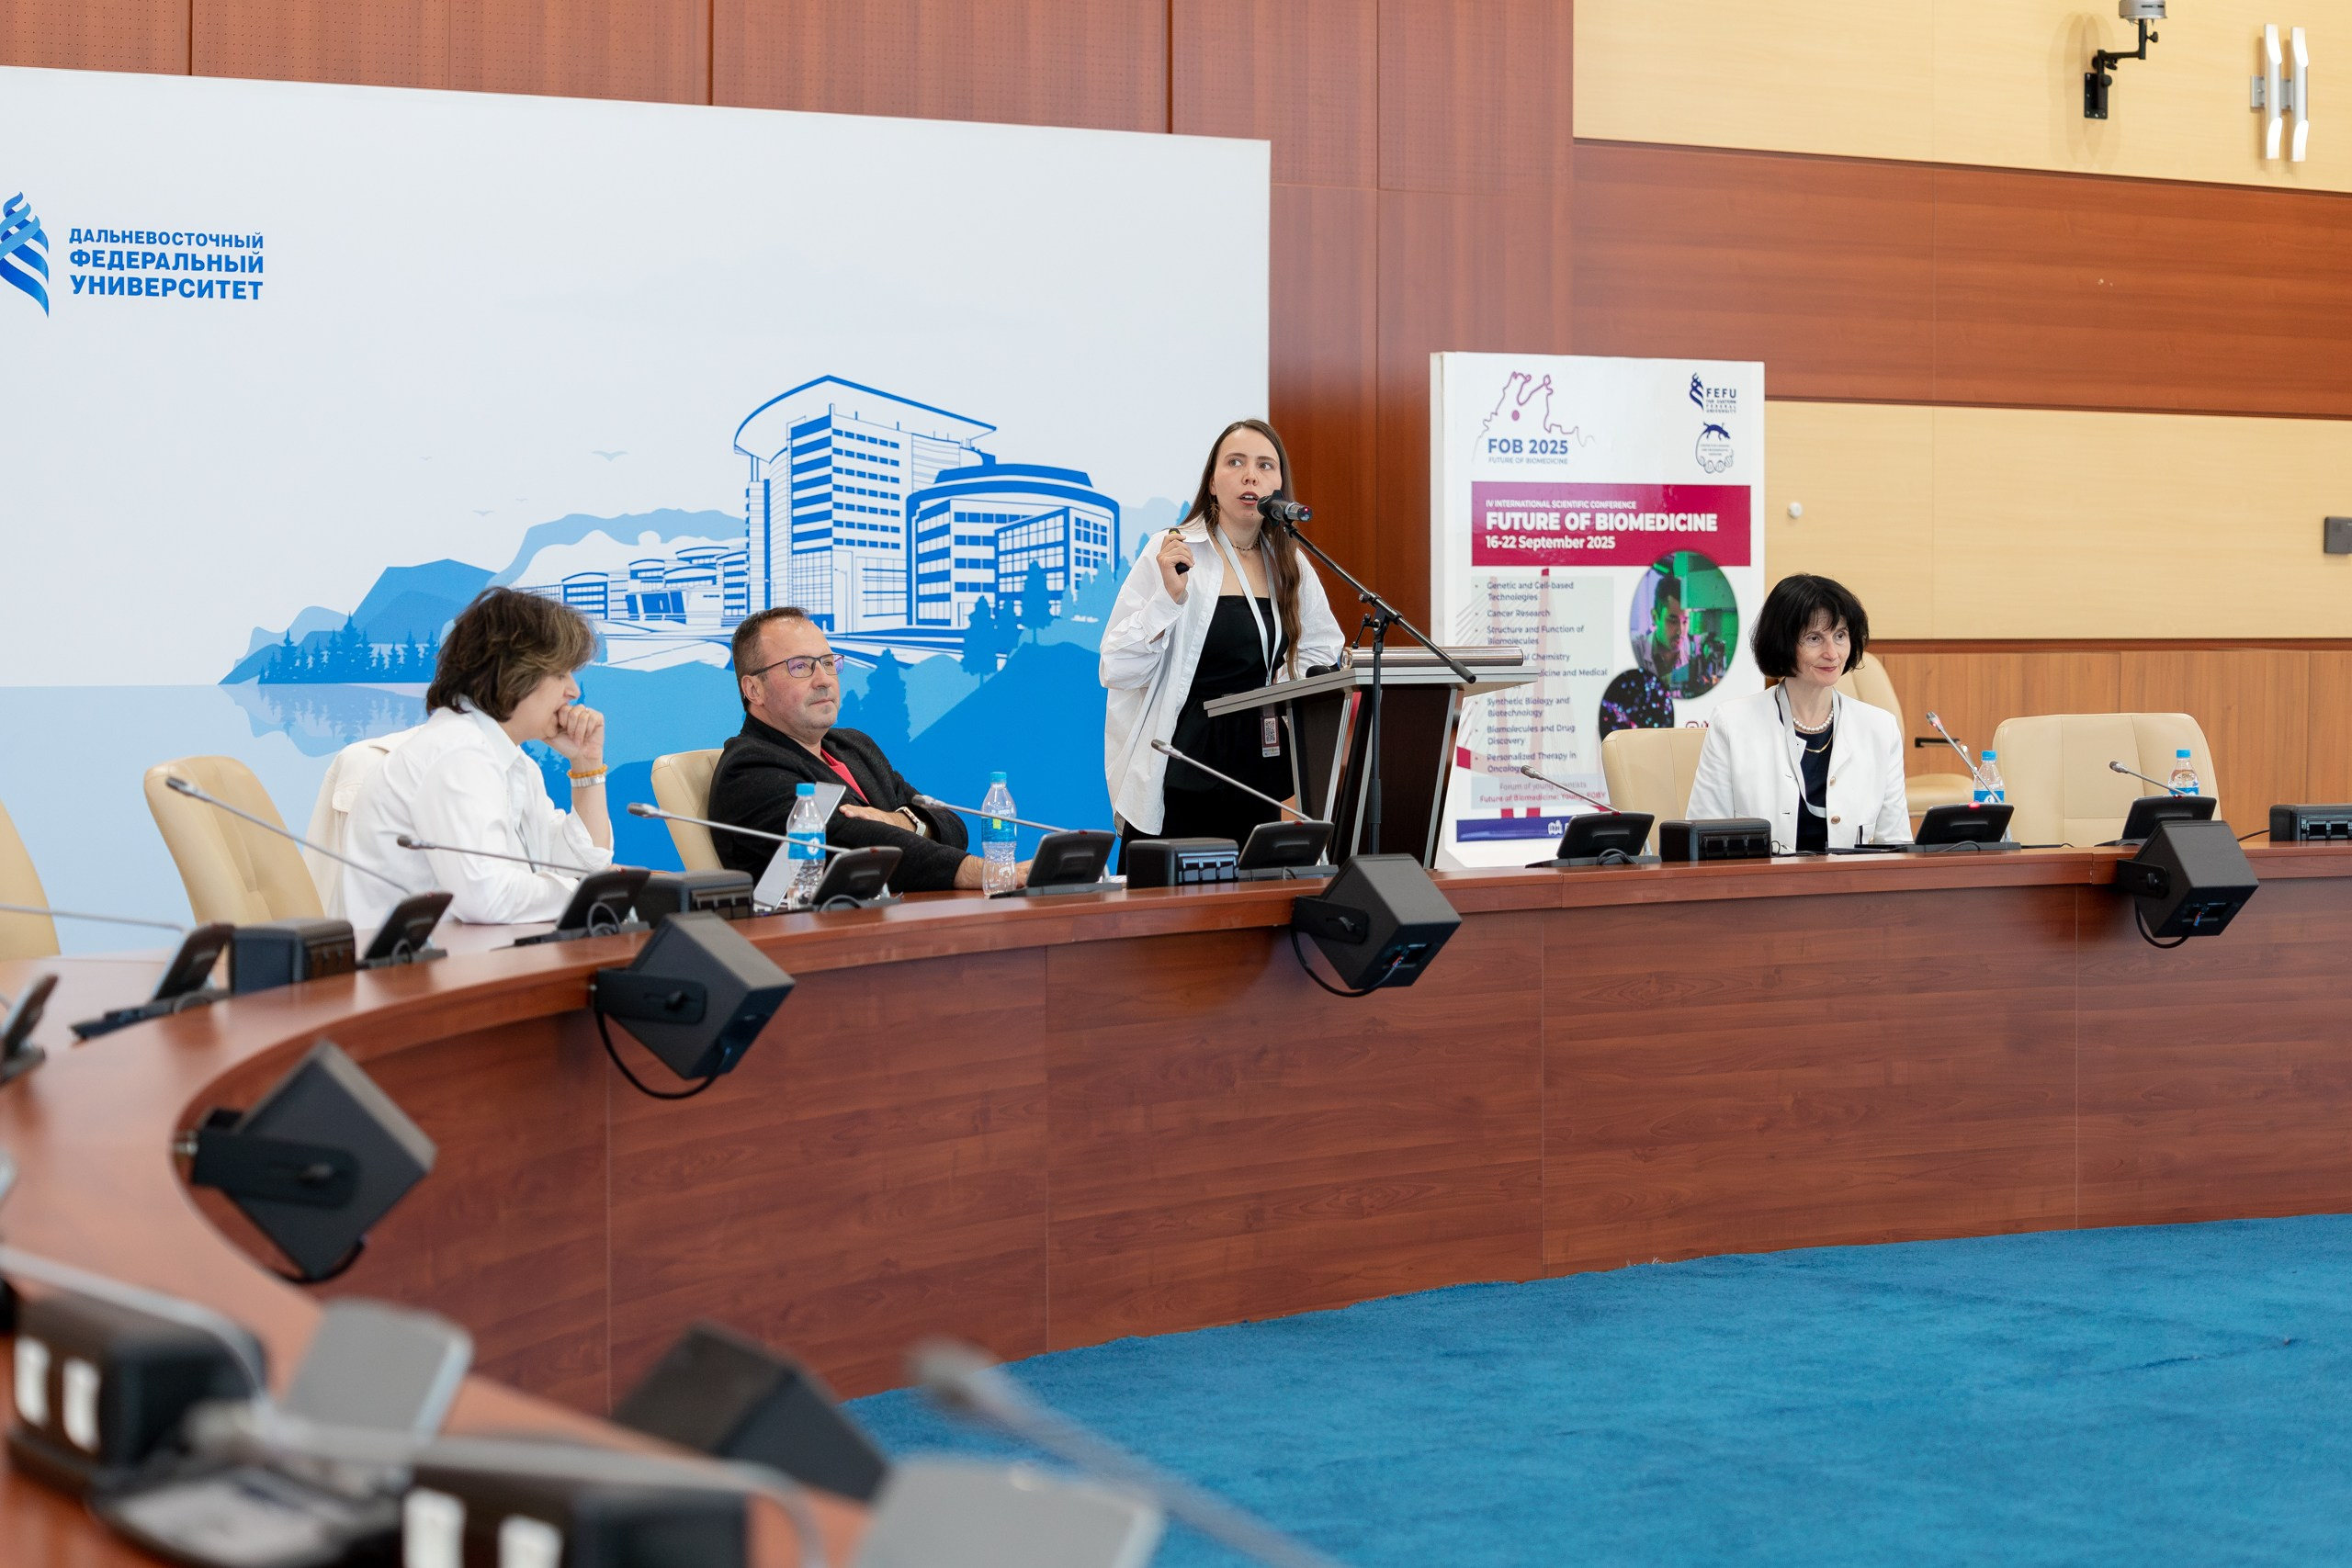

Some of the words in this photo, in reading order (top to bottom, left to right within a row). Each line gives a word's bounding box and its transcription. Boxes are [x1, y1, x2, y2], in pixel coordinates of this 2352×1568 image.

[69, 228, 264, 249] ДАЛЬНЕВОСТОЧНЫЙ
[70, 249, 264, 274] ФЕДЕРАЛЬНЫЙ
[70, 275, 264, 300] УНИВЕРСИТЕТ
[1706, 388, 1736, 399] FEFU
[1488, 438, 1523, 454] FOB
[1529, 439, 1568, 455] 2025
[1486, 499, 1494, 507] IV
[1495, 500, 1551, 508] INTERNATIONAL
[1552, 501, 1589, 509] SCIENTIFIC
[1590, 501, 1636, 510] CONFERENCE
[1486, 512, 1560, 530] FUTURE
[1565, 513, 1591, 531] OF
[1595, 513, 1718, 532] BIOMEDICINE
[1486, 535, 1517, 548] 16-22
[1519, 536, 1585, 551] September
[1587, 536, 1615, 549] 2025
[1487, 581, 1516, 590] Genetic
[1487, 593, 1538, 602] Technologies
[1487, 626, 1522, 634] Structure
[1487, 637, 1539, 645] Biomolecules
[1532, 653, 1570, 662] Chemistry
[1563, 669, 1577, 677] and
[1487, 696, 1522, 705] Synthetic
[1525, 696, 1553, 705] Biology
[1555, 696, 1570, 705] and
[1487, 708, 1543, 717] Biotechnology
[1487, 726, 1538, 734] Biomolecules
[1540, 725, 1555, 733] and
[1556, 725, 1576, 733] Drug
[1487, 737, 1525, 746] Discovery
[1538, 751, 1567, 761] Therapy
[1569, 751, 1577, 760] in
[1487, 764, 1521, 773] Oncolog
[1499, 783, 1521, 791] Forum
[1523, 782, 1531, 790] of
[1480, 795, 1503, 803] Future
